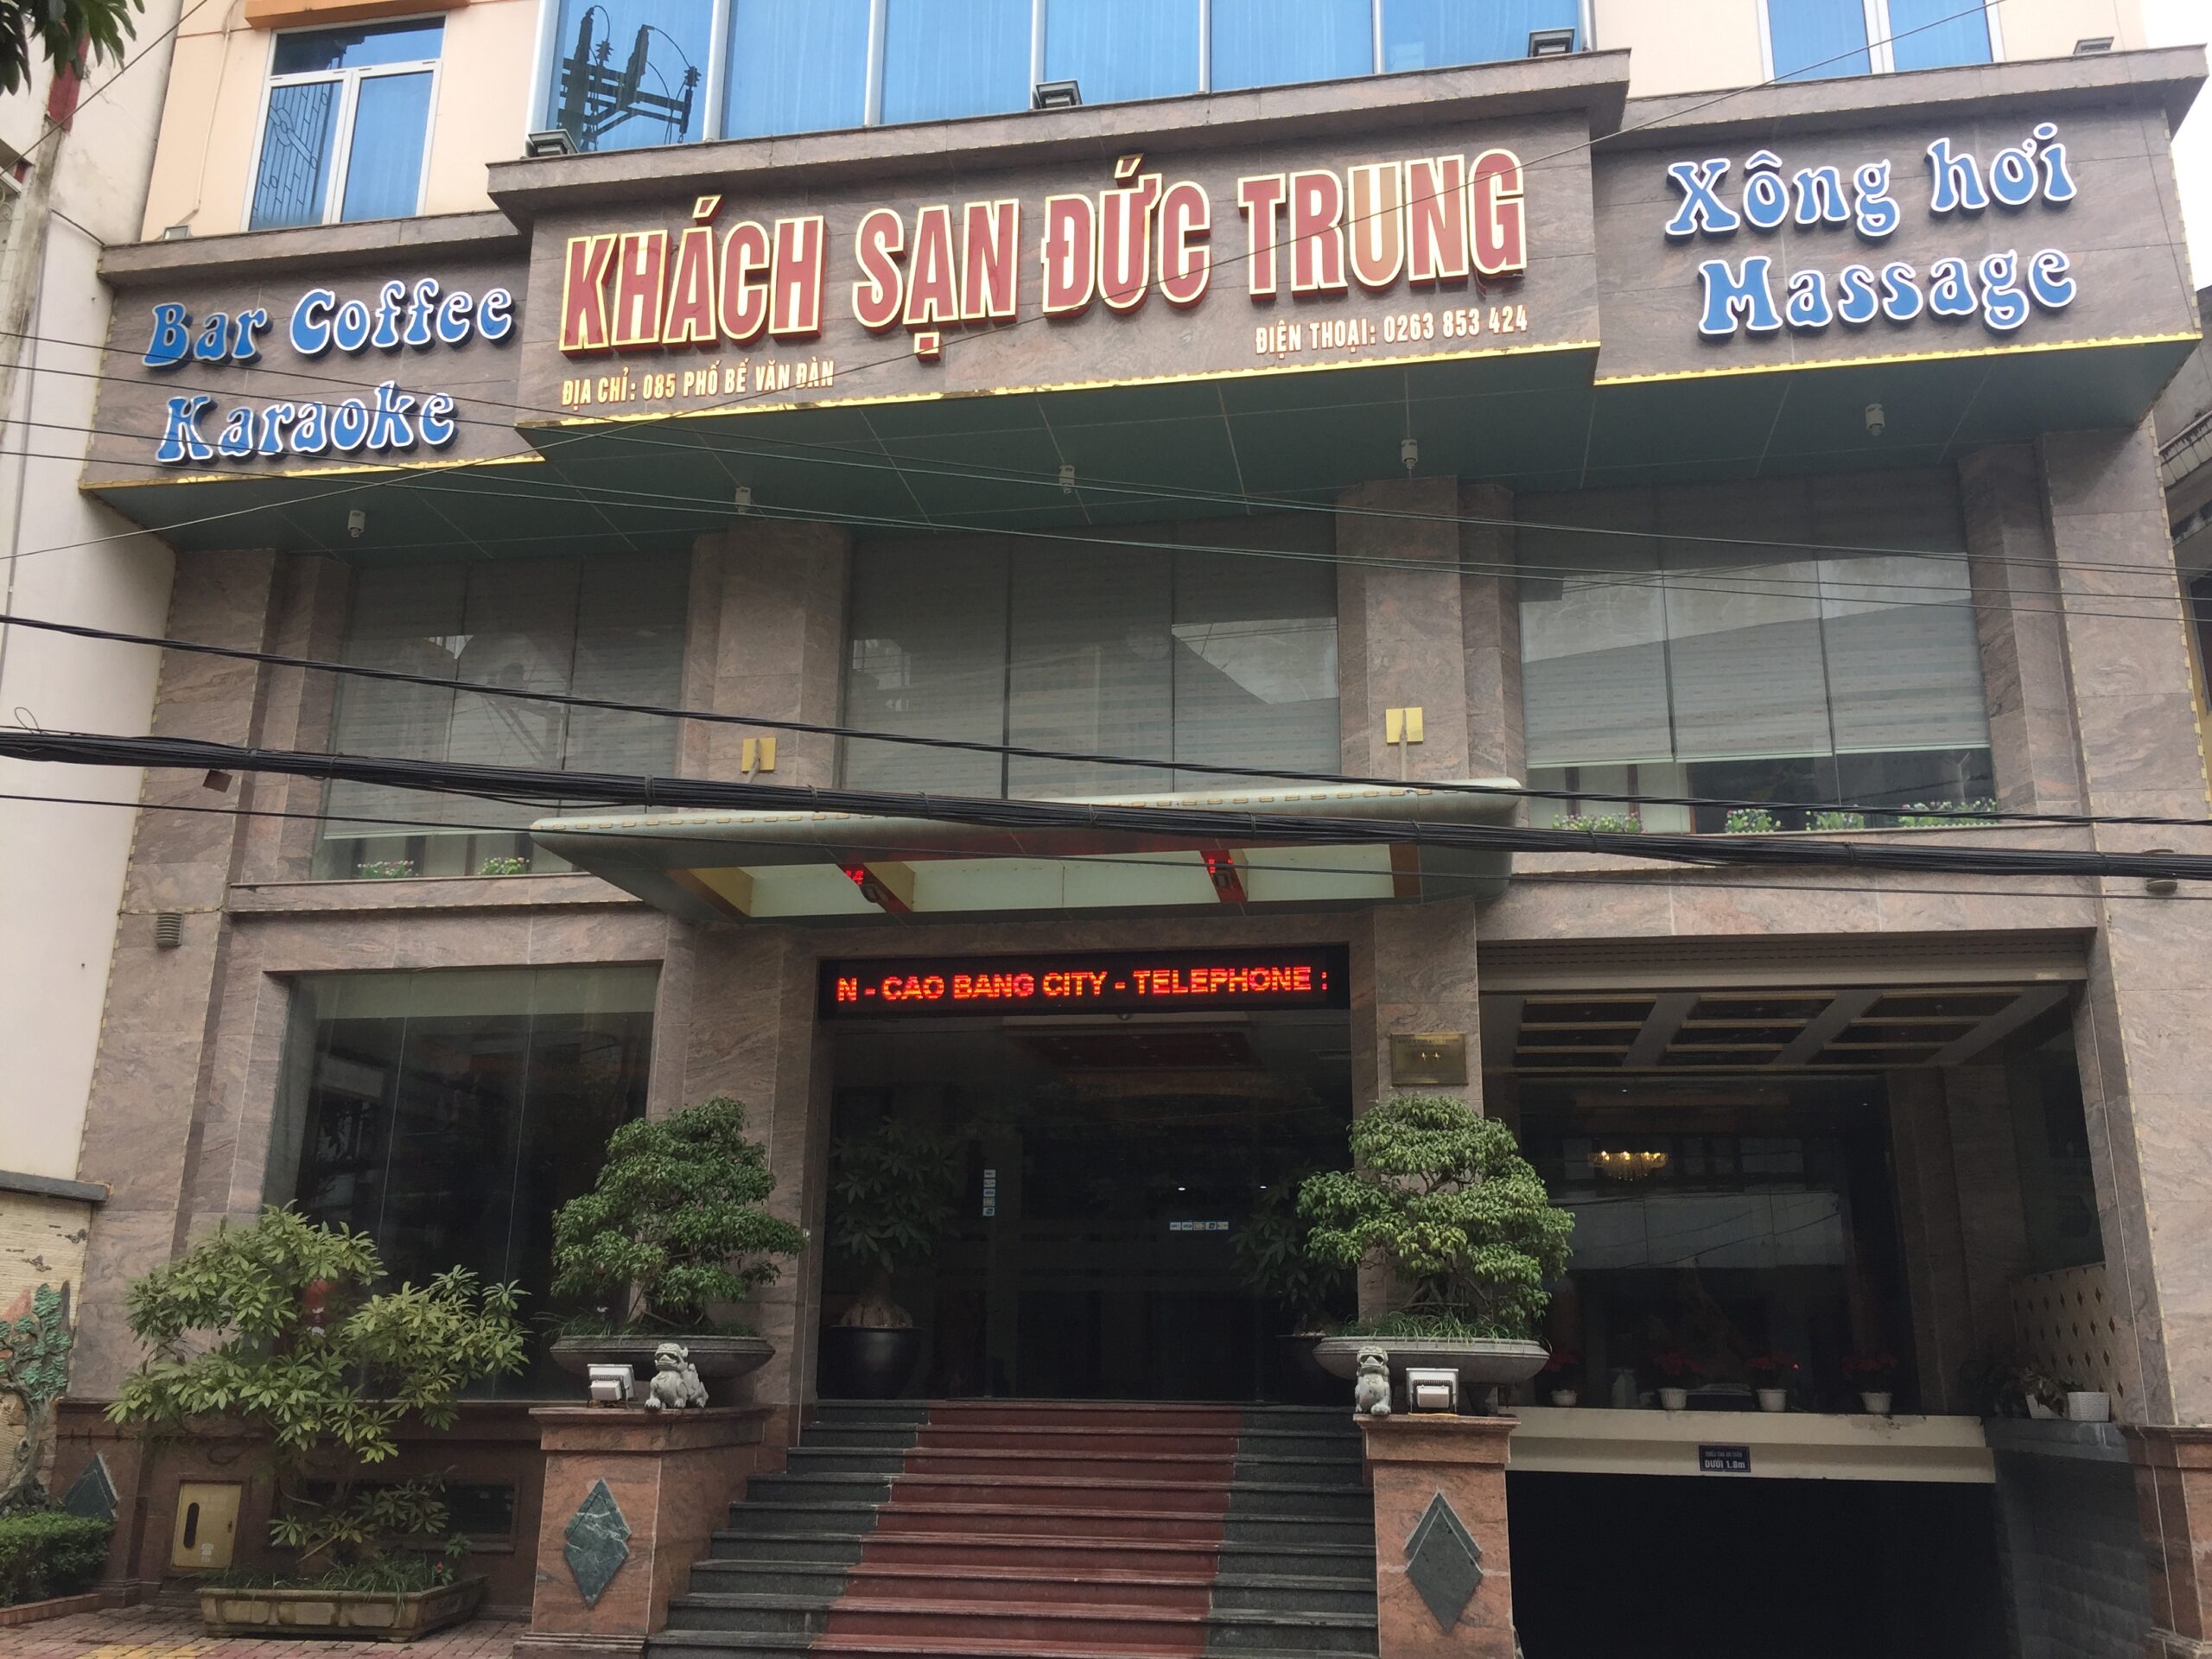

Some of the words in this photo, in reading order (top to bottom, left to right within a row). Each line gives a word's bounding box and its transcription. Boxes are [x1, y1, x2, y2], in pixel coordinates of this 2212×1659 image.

[1665, 149, 1901, 237] Xông
[1928, 122, 2077, 213] hơi
[560, 194, 827, 353] KHÁCH
[852, 199, 1022, 359] SẠN
[1040, 153, 1211, 311] ĐỨC
[1238, 148, 1528, 301] TRUNG
[1698, 248, 2077, 335] Massage
[142, 302, 269, 367] Bar
[289, 277, 513, 355] Coffee
[1255, 320, 1301, 359] ĐIỆN
[1309, 318, 1376, 353] THOẠI:
[1383, 312, 1434, 343] 0263
[1442, 308, 1480, 338] 853
[1488, 304, 1528, 334] 424
[156, 379, 454, 464] Karaoke
[562, 378, 591, 411] ĐỊA
[642, 373, 676, 401] 085
[683, 359, 721, 397] PHỐ
[724, 358, 750, 395] BẾ
[755, 359, 791, 392] VĂN
[795, 356, 835, 389] ĐÀN
[881, 976, 944, 1001] CAO
[953, 973, 1035, 1000] BANG
[1042, 970, 1108, 997] CITY
[1133, 967, 1312, 995] TELEPHONE
